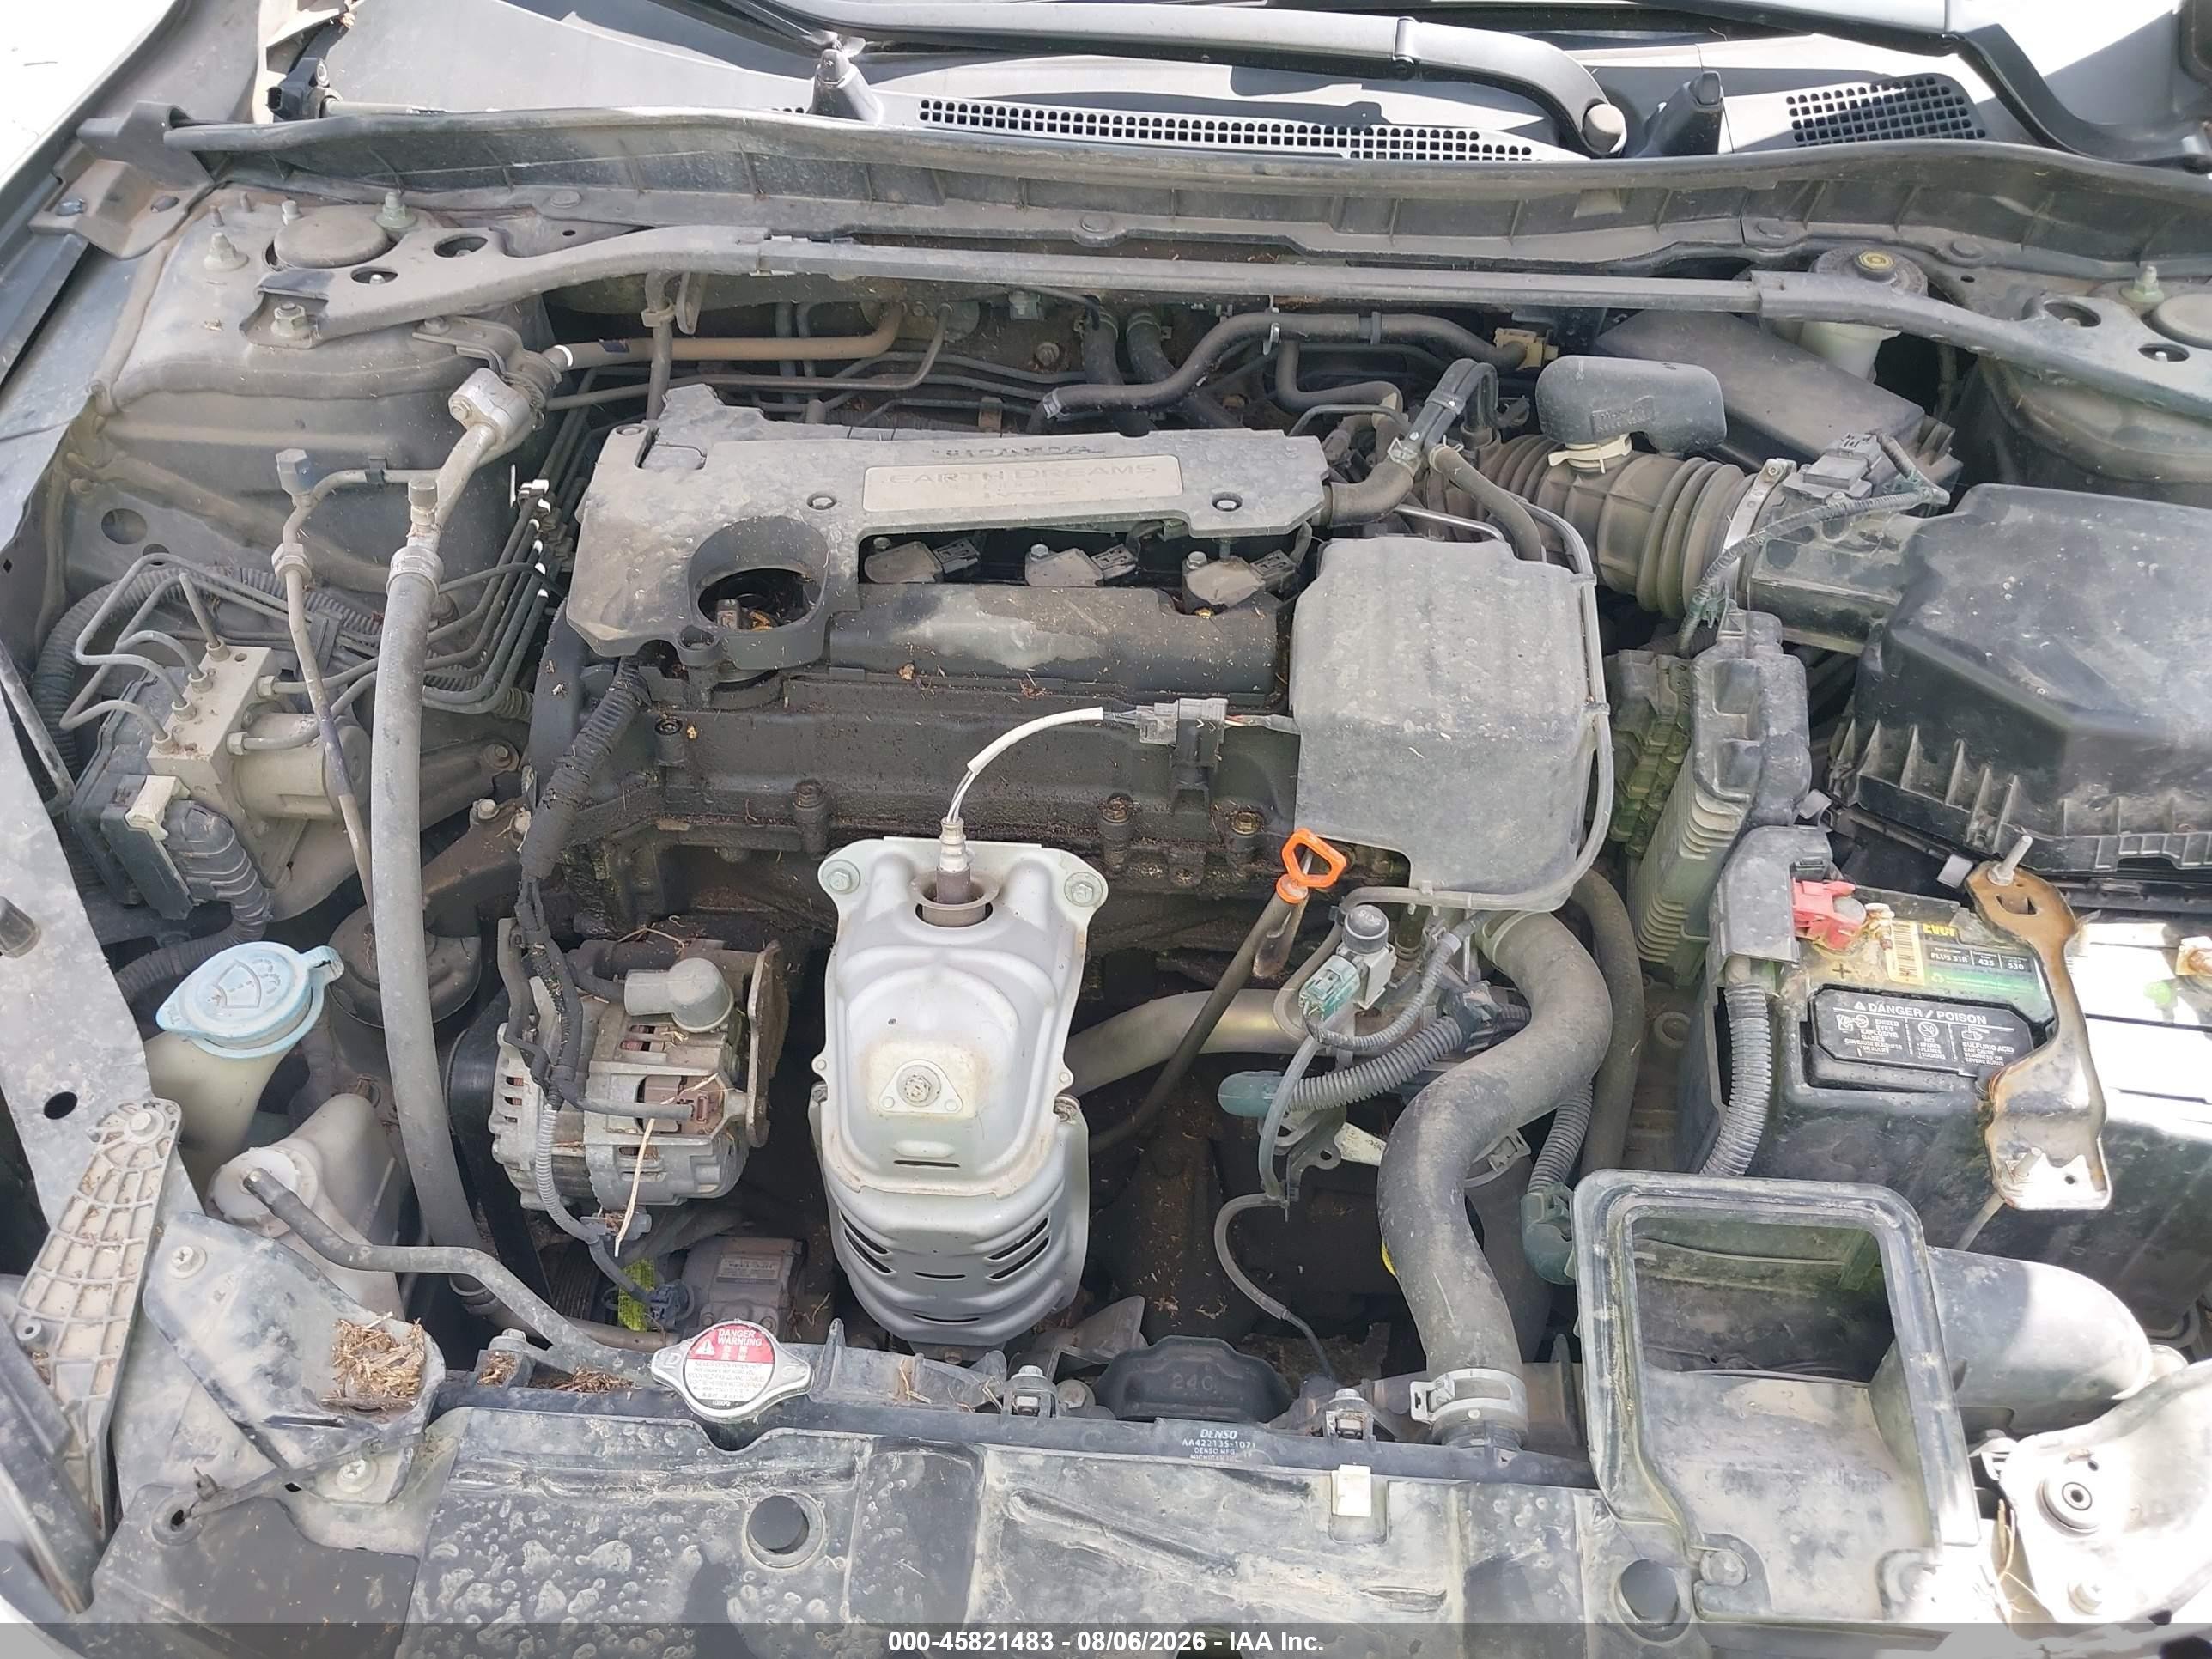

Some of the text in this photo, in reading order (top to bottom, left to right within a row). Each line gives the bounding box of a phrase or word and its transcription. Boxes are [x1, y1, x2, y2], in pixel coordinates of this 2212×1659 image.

[890, 464, 1157, 483] EARTH DREAMS
[1930, 952, 1951, 961] PLUS
[1868, 1001, 1923, 1018] DANGER
[1936, 1010, 1987, 1025] POISON
[1875, 1018, 1899, 1027] SHIELD
[718, 1329, 756, 1339] DANGER
[717, 1336, 763, 1347] WARNUNG
[1200, 1429, 1238, 1440] DENSO
